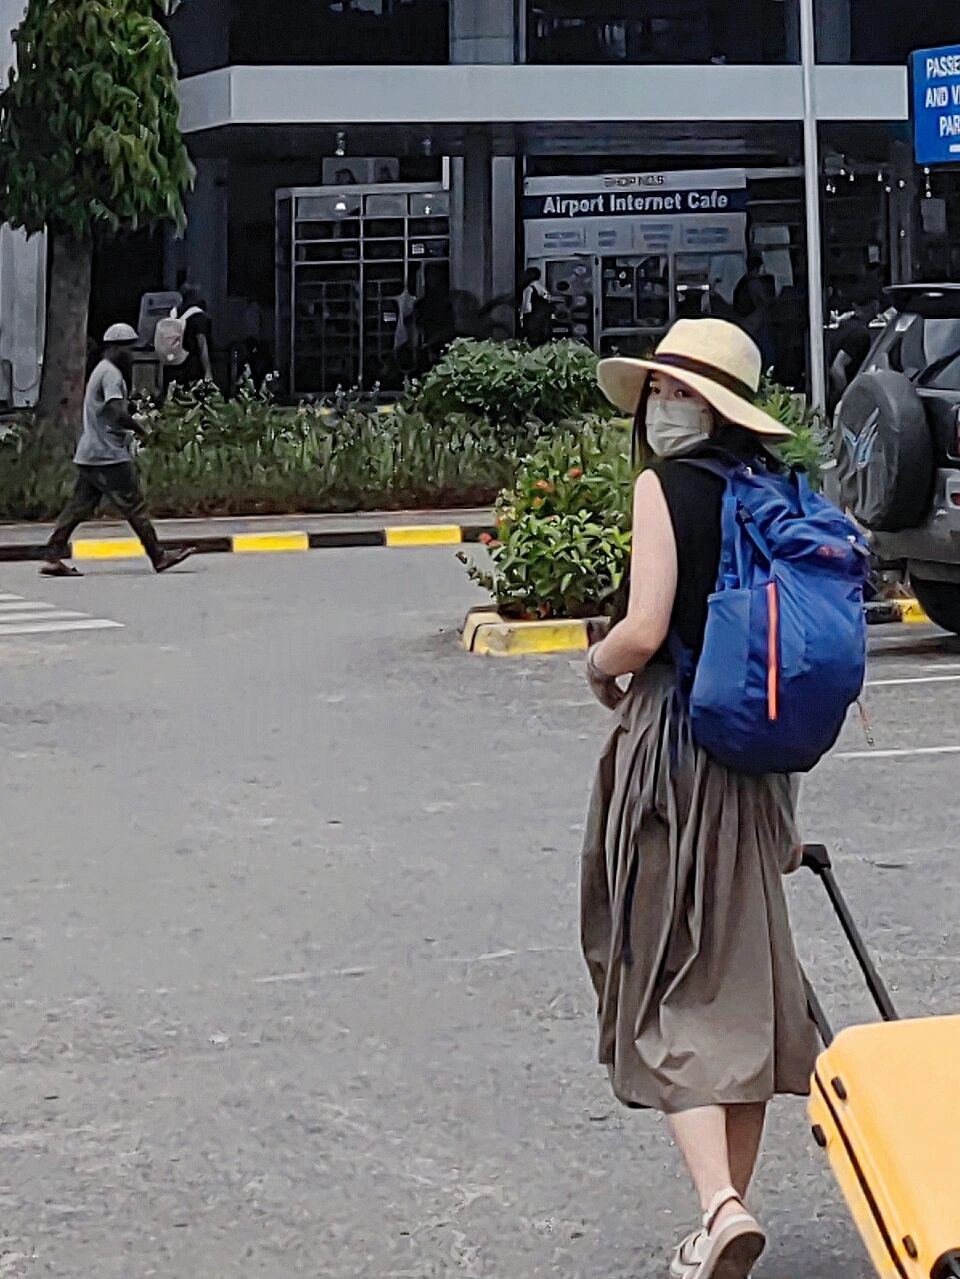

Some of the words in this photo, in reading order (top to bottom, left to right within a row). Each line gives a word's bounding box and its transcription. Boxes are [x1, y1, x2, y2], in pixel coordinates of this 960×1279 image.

[925, 86, 948, 108] AND
[542, 194, 604, 218] Airport
[610, 193, 681, 212] Internet
[687, 190, 728, 209] Cafe
